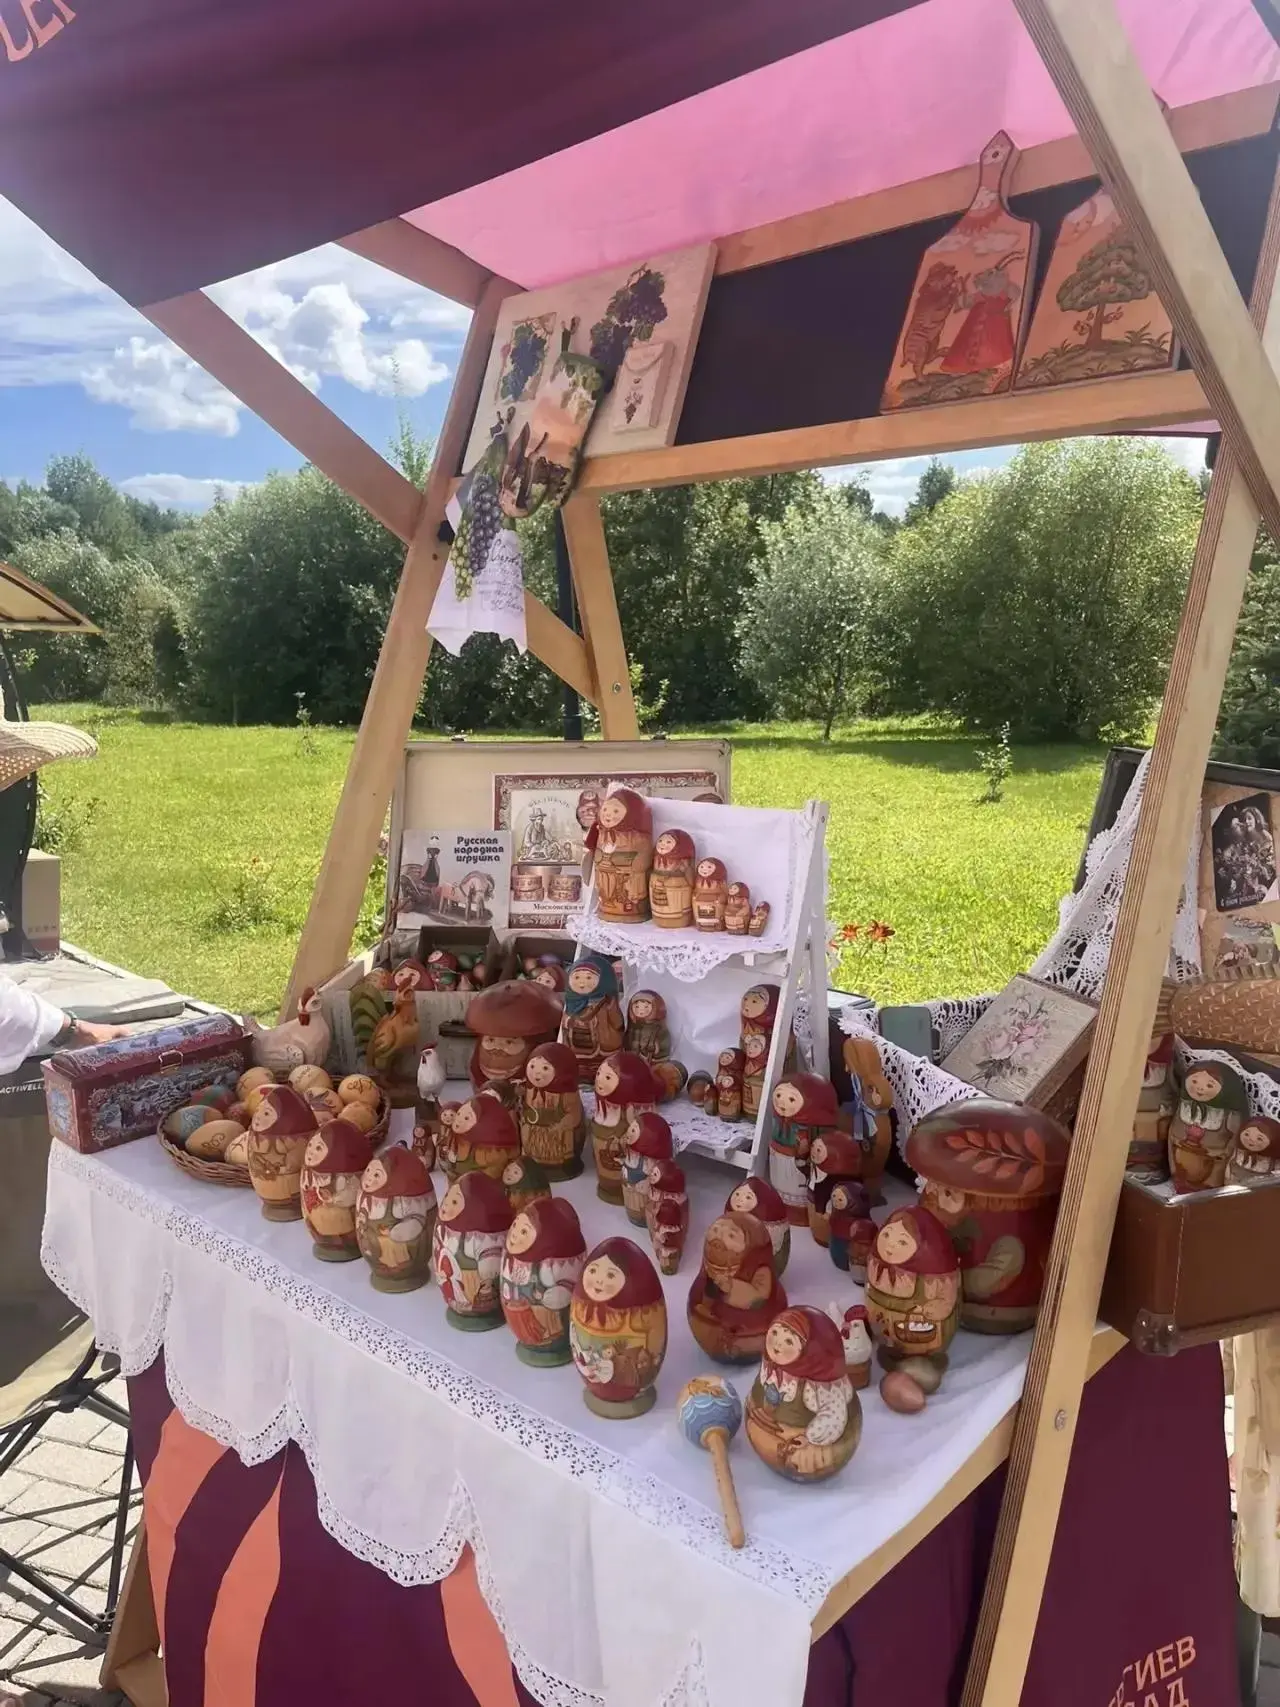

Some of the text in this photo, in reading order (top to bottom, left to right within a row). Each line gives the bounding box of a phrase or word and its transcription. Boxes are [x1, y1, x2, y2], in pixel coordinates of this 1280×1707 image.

[457, 836, 498, 846] Русская
[454, 846, 504, 855] народная
[456, 855, 500, 864] игрушка
